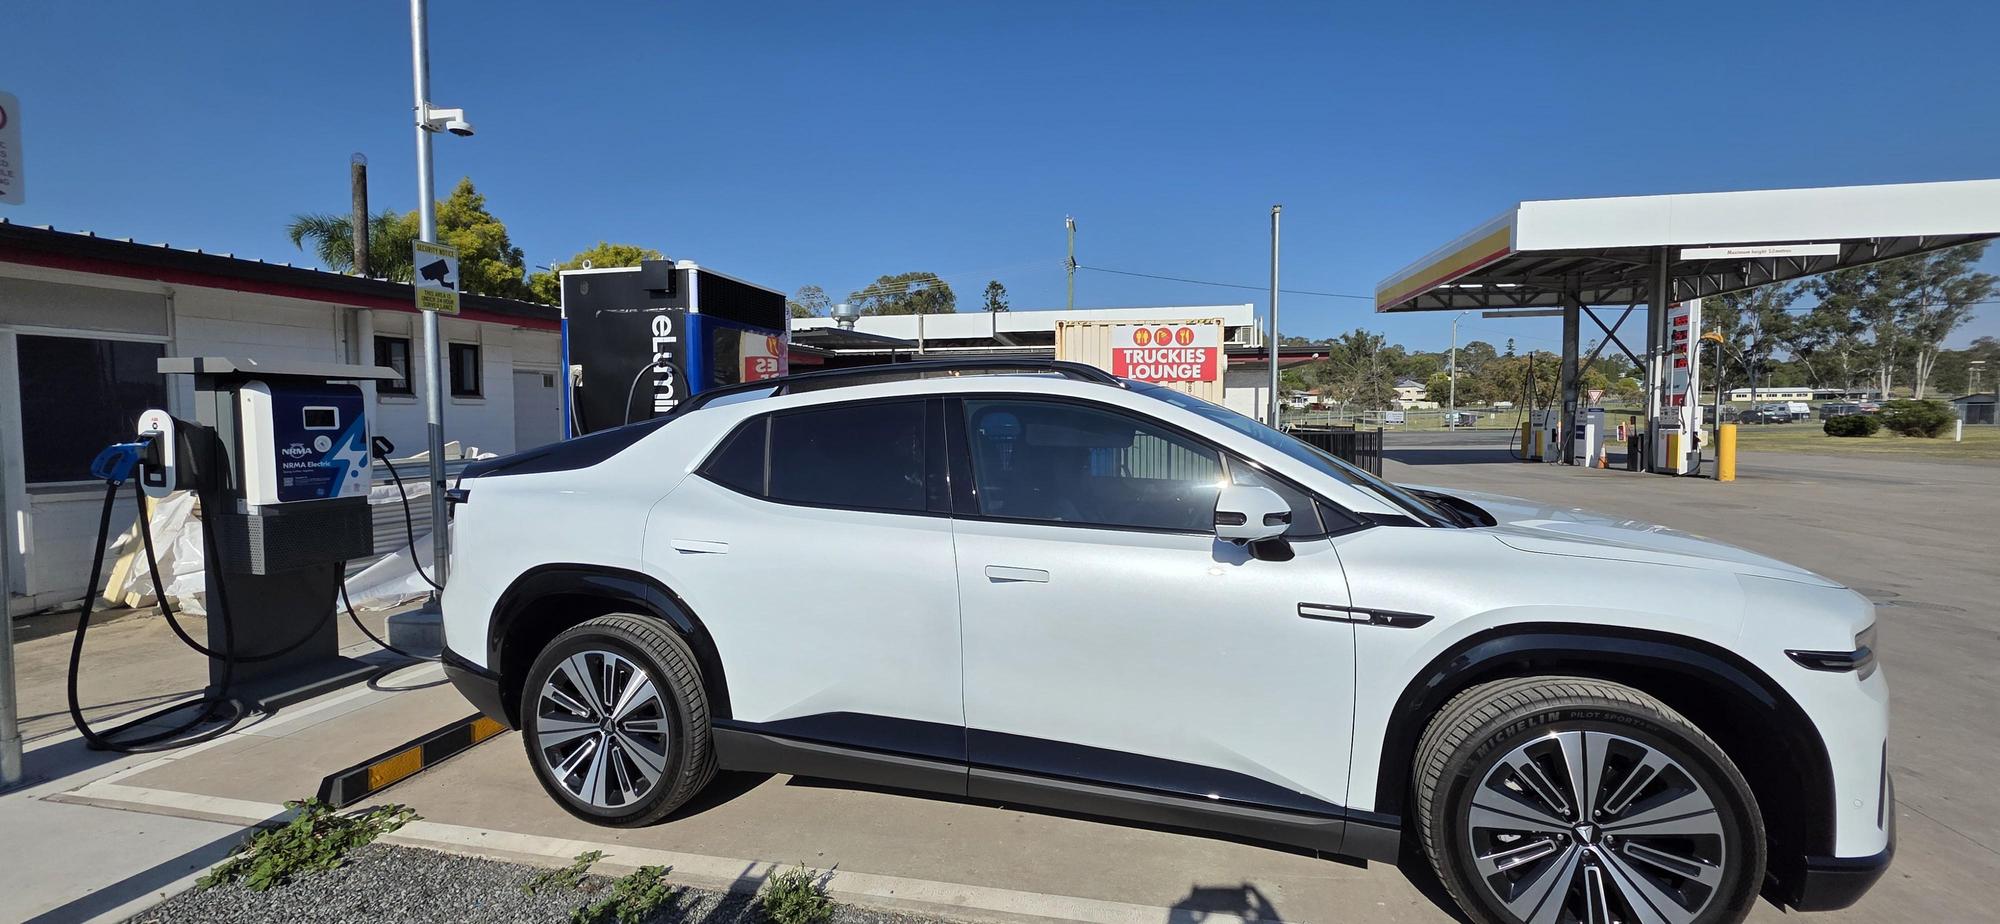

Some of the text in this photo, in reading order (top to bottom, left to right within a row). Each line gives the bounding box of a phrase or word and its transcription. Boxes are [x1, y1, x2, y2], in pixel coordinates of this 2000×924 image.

[1124, 349, 1206, 364] TRUCKIES
[1128, 364, 1201, 379] LOUNGE
[1477, 712, 1560, 757] MICHELIN
[1570, 711, 1600, 719] PILOT
